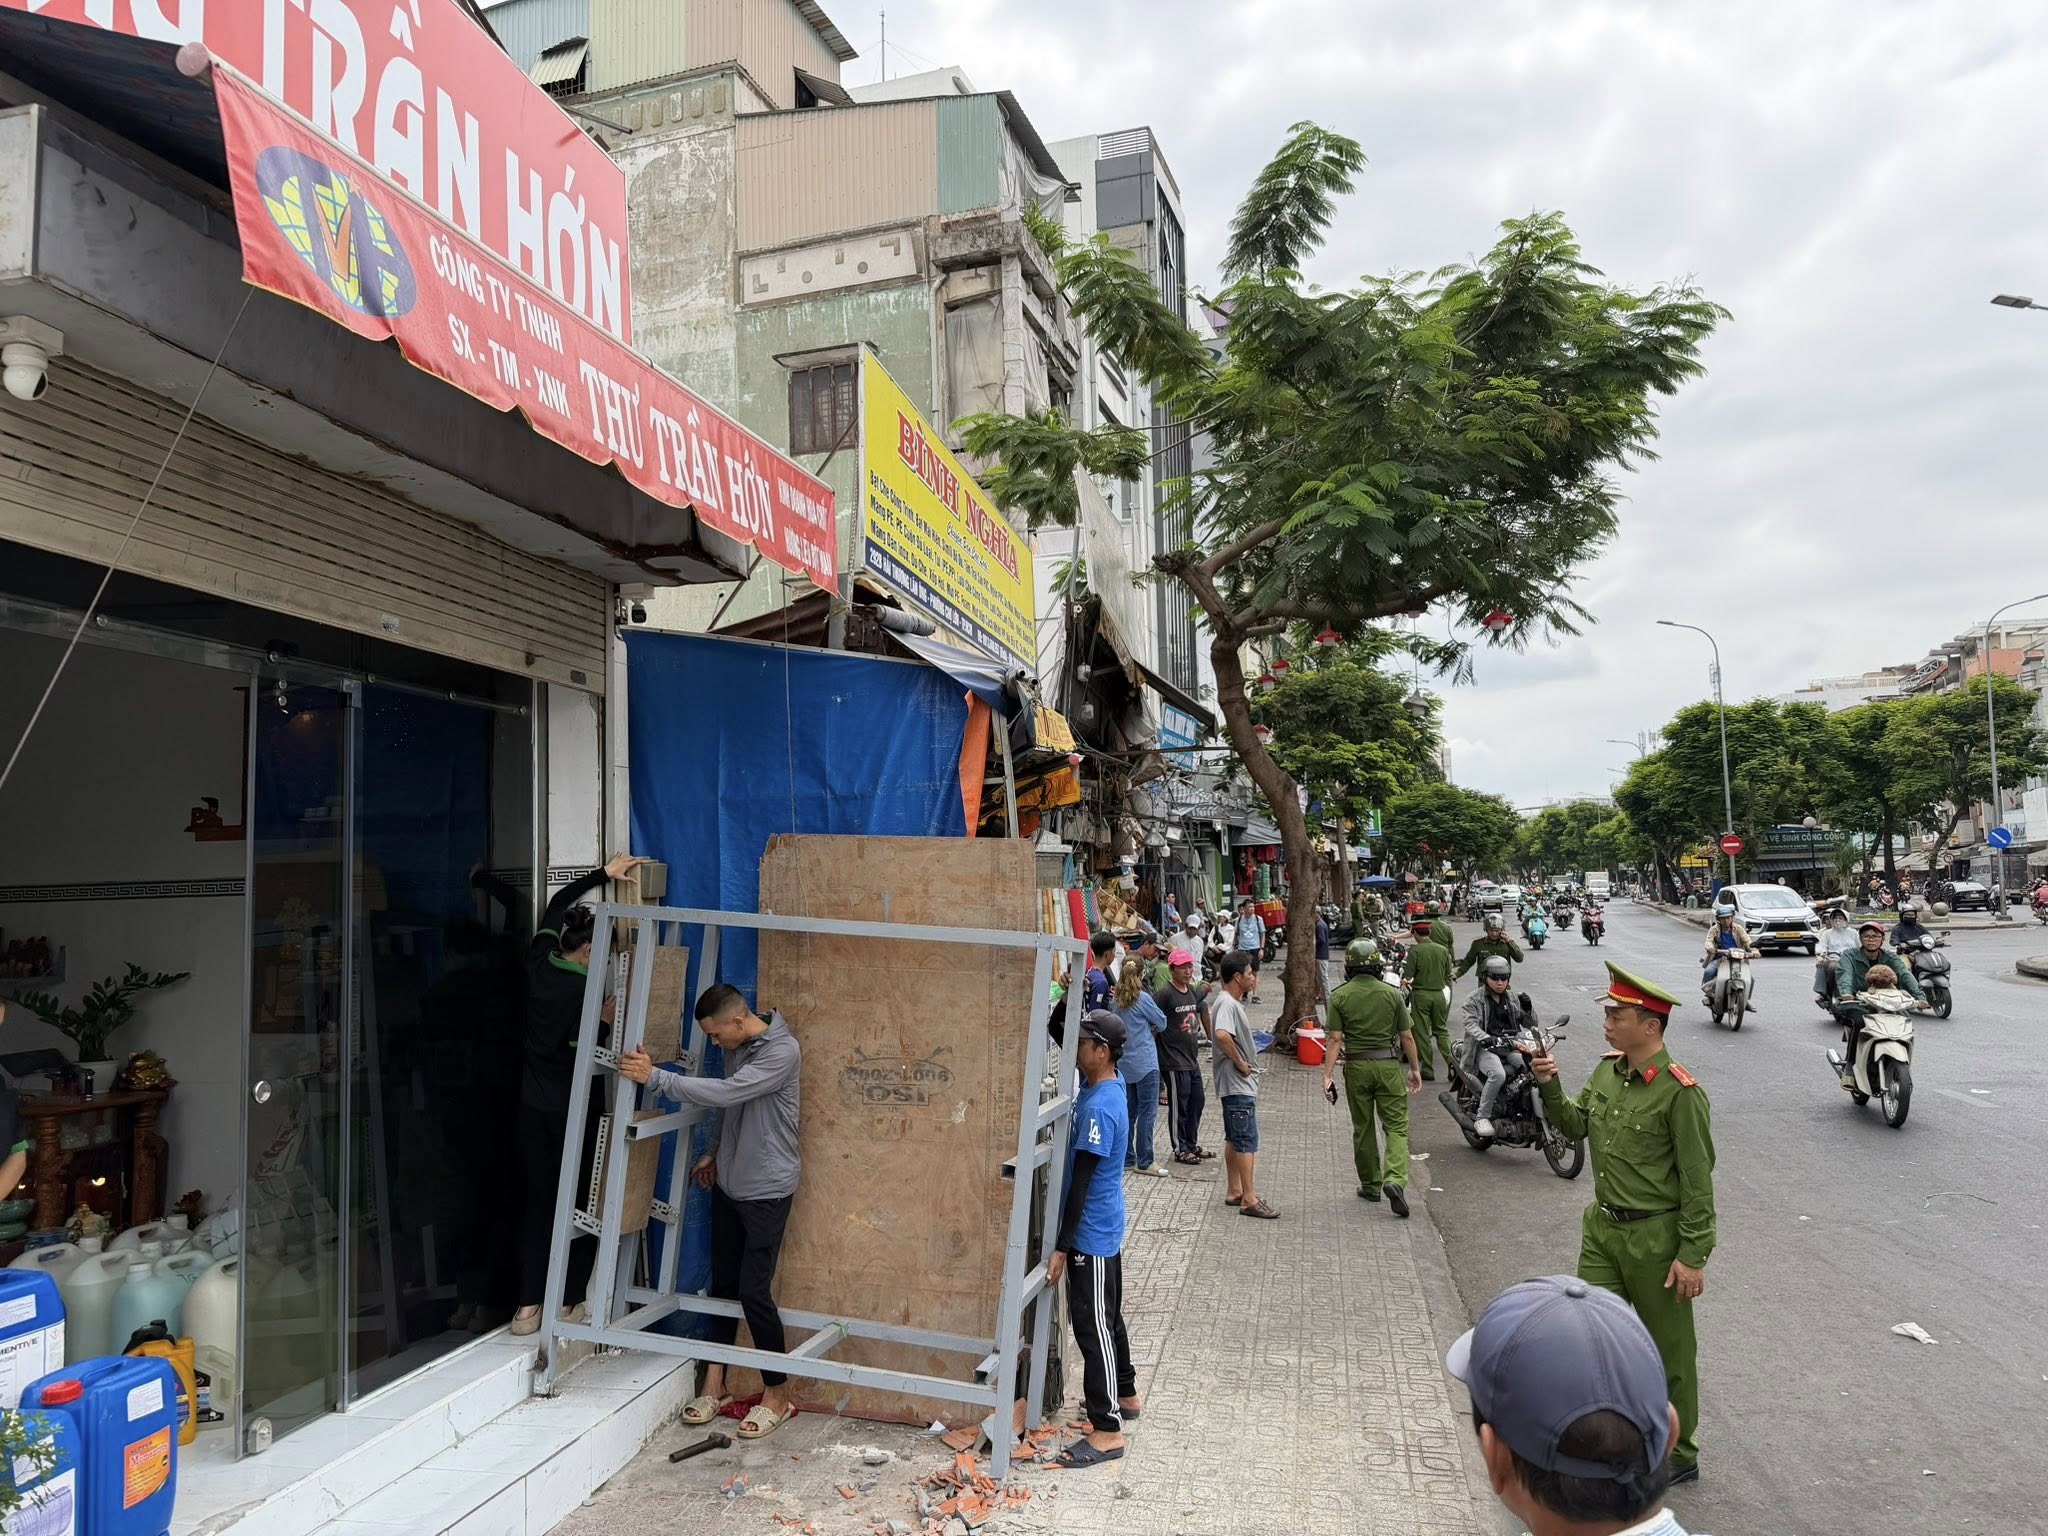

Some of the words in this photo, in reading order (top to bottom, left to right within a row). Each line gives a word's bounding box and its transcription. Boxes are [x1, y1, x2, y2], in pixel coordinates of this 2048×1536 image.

[429, 233, 486, 305] CÔNG
[486, 273, 512, 321] TY
[515, 293, 564, 355] TNHH
[506, 147, 623, 340] HỚN
[448, 313, 476, 364] SX
[488, 338, 521, 391] TM
[533, 365, 572, 420] XNK
[579, 358, 644, 470] THƯ
[650, 404, 725, 514] TRẦN
[724, 449, 775, 543] HỚN
[870, 469, 878, 493] Bạt
[879, 478, 888, 499] Che
[890, 487, 901, 513] Công
[897, 408, 960, 522] BÌNH
[964, 488, 1021, 586] NGHĨA
[896, 516, 902, 535] PE
[1770, 834, 1780, 844] VỆ
[1782, 833, 1800, 842] SINH
[1801, 832, 1822, 841] CÔNG
